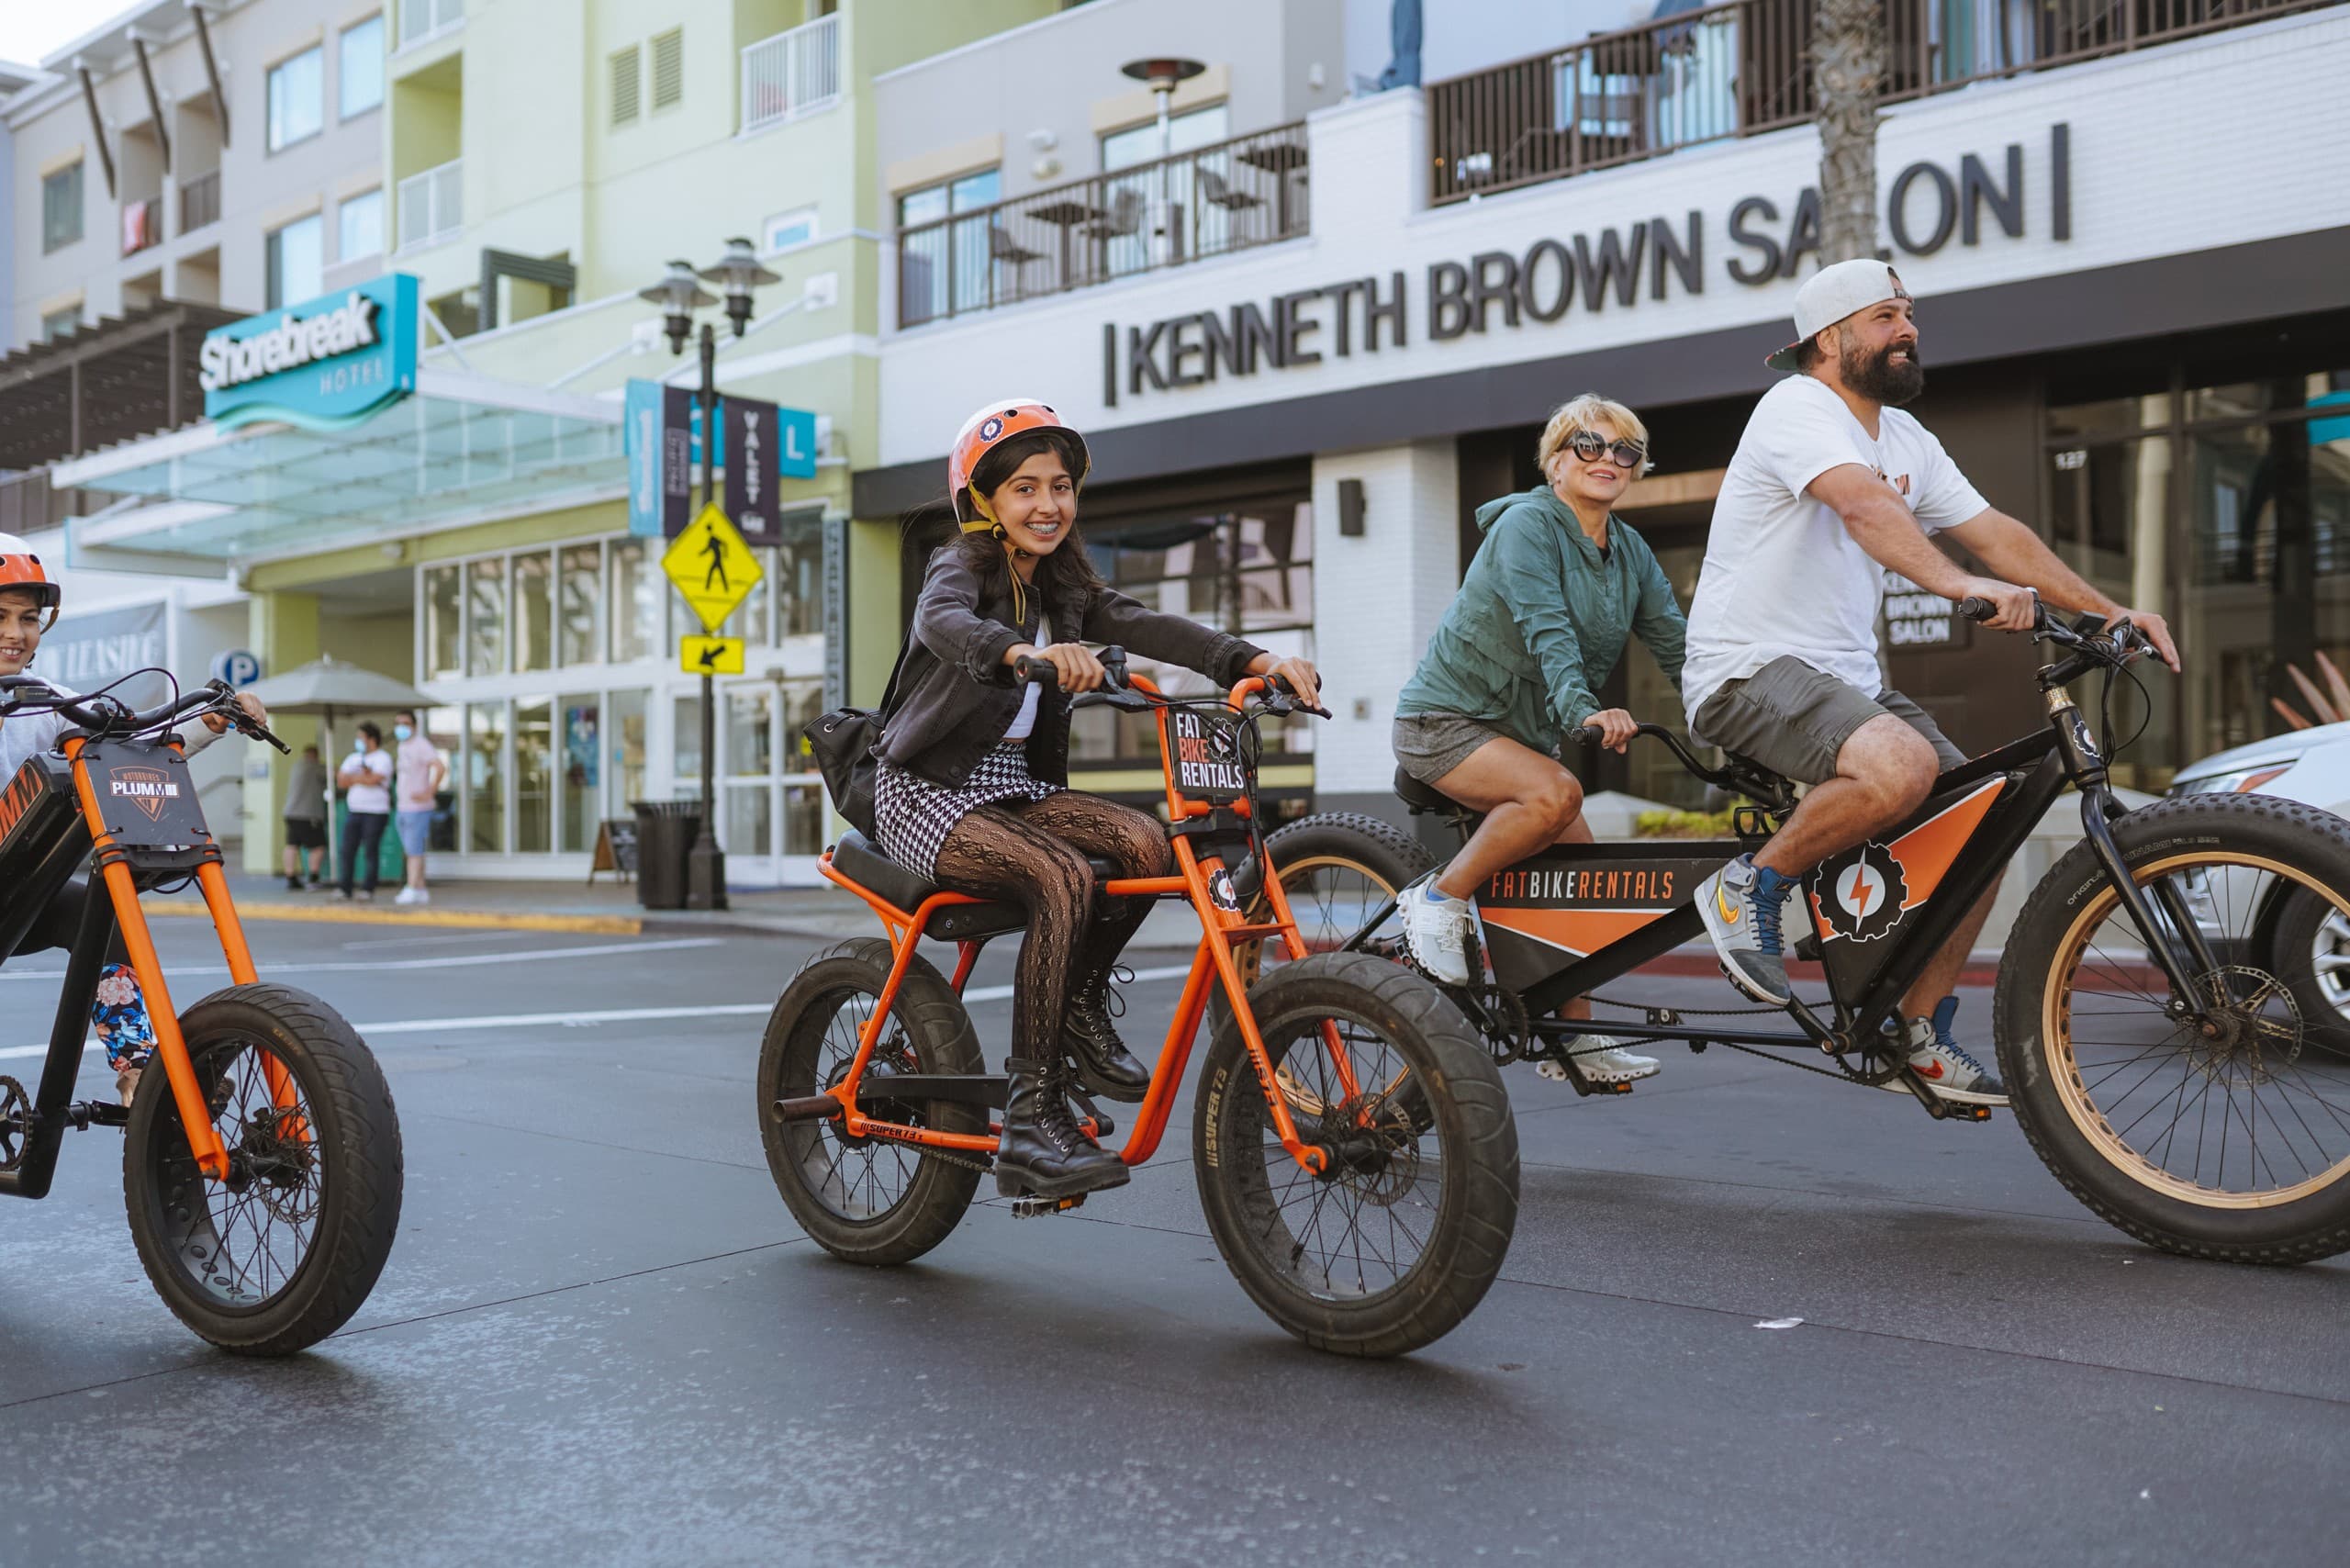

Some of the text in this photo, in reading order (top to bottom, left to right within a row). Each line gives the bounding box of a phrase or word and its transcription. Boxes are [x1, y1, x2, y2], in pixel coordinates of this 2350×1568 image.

[1128, 143, 2025, 395] KENNETH BROWN SAON
[198, 291, 377, 392] Shorebreak
[319, 357, 384, 397] HOTEL
[743, 410, 761, 505] VALET
[1889, 617, 1951, 644] SALON
[1175, 712, 1201, 739] FAT
[1178, 737, 1210, 763] BIKE
[1181, 761, 1245, 790] RENTALS
